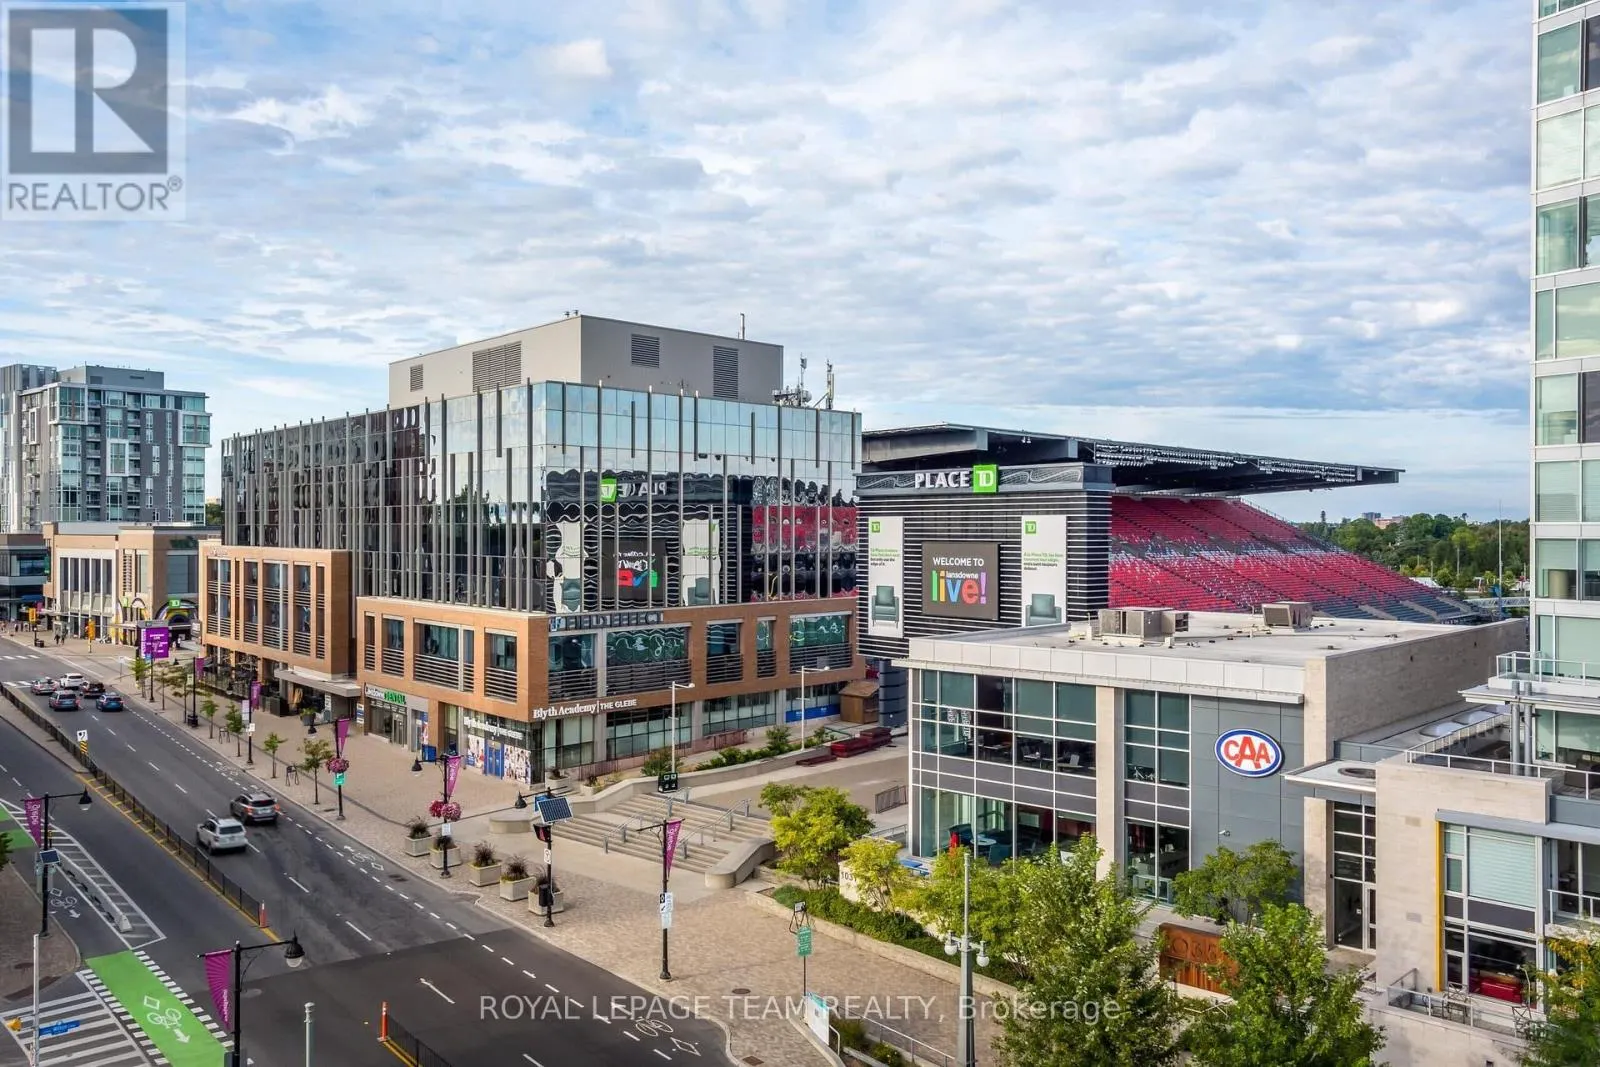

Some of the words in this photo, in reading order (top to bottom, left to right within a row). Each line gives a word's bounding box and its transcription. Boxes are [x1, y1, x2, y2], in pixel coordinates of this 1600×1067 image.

[915, 471, 970, 489] PLACE
[975, 470, 994, 487] TD
[932, 557, 972, 567] WELCOME
[972, 557, 985, 567] TO
[931, 569, 987, 605] live!
[533, 707, 558, 720] Blyth
[558, 702, 597, 715] Academy
[600, 702, 614, 711] THE
[615, 698, 638, 709] GLEBE
[1223, 736, 1271, 769] CAA
